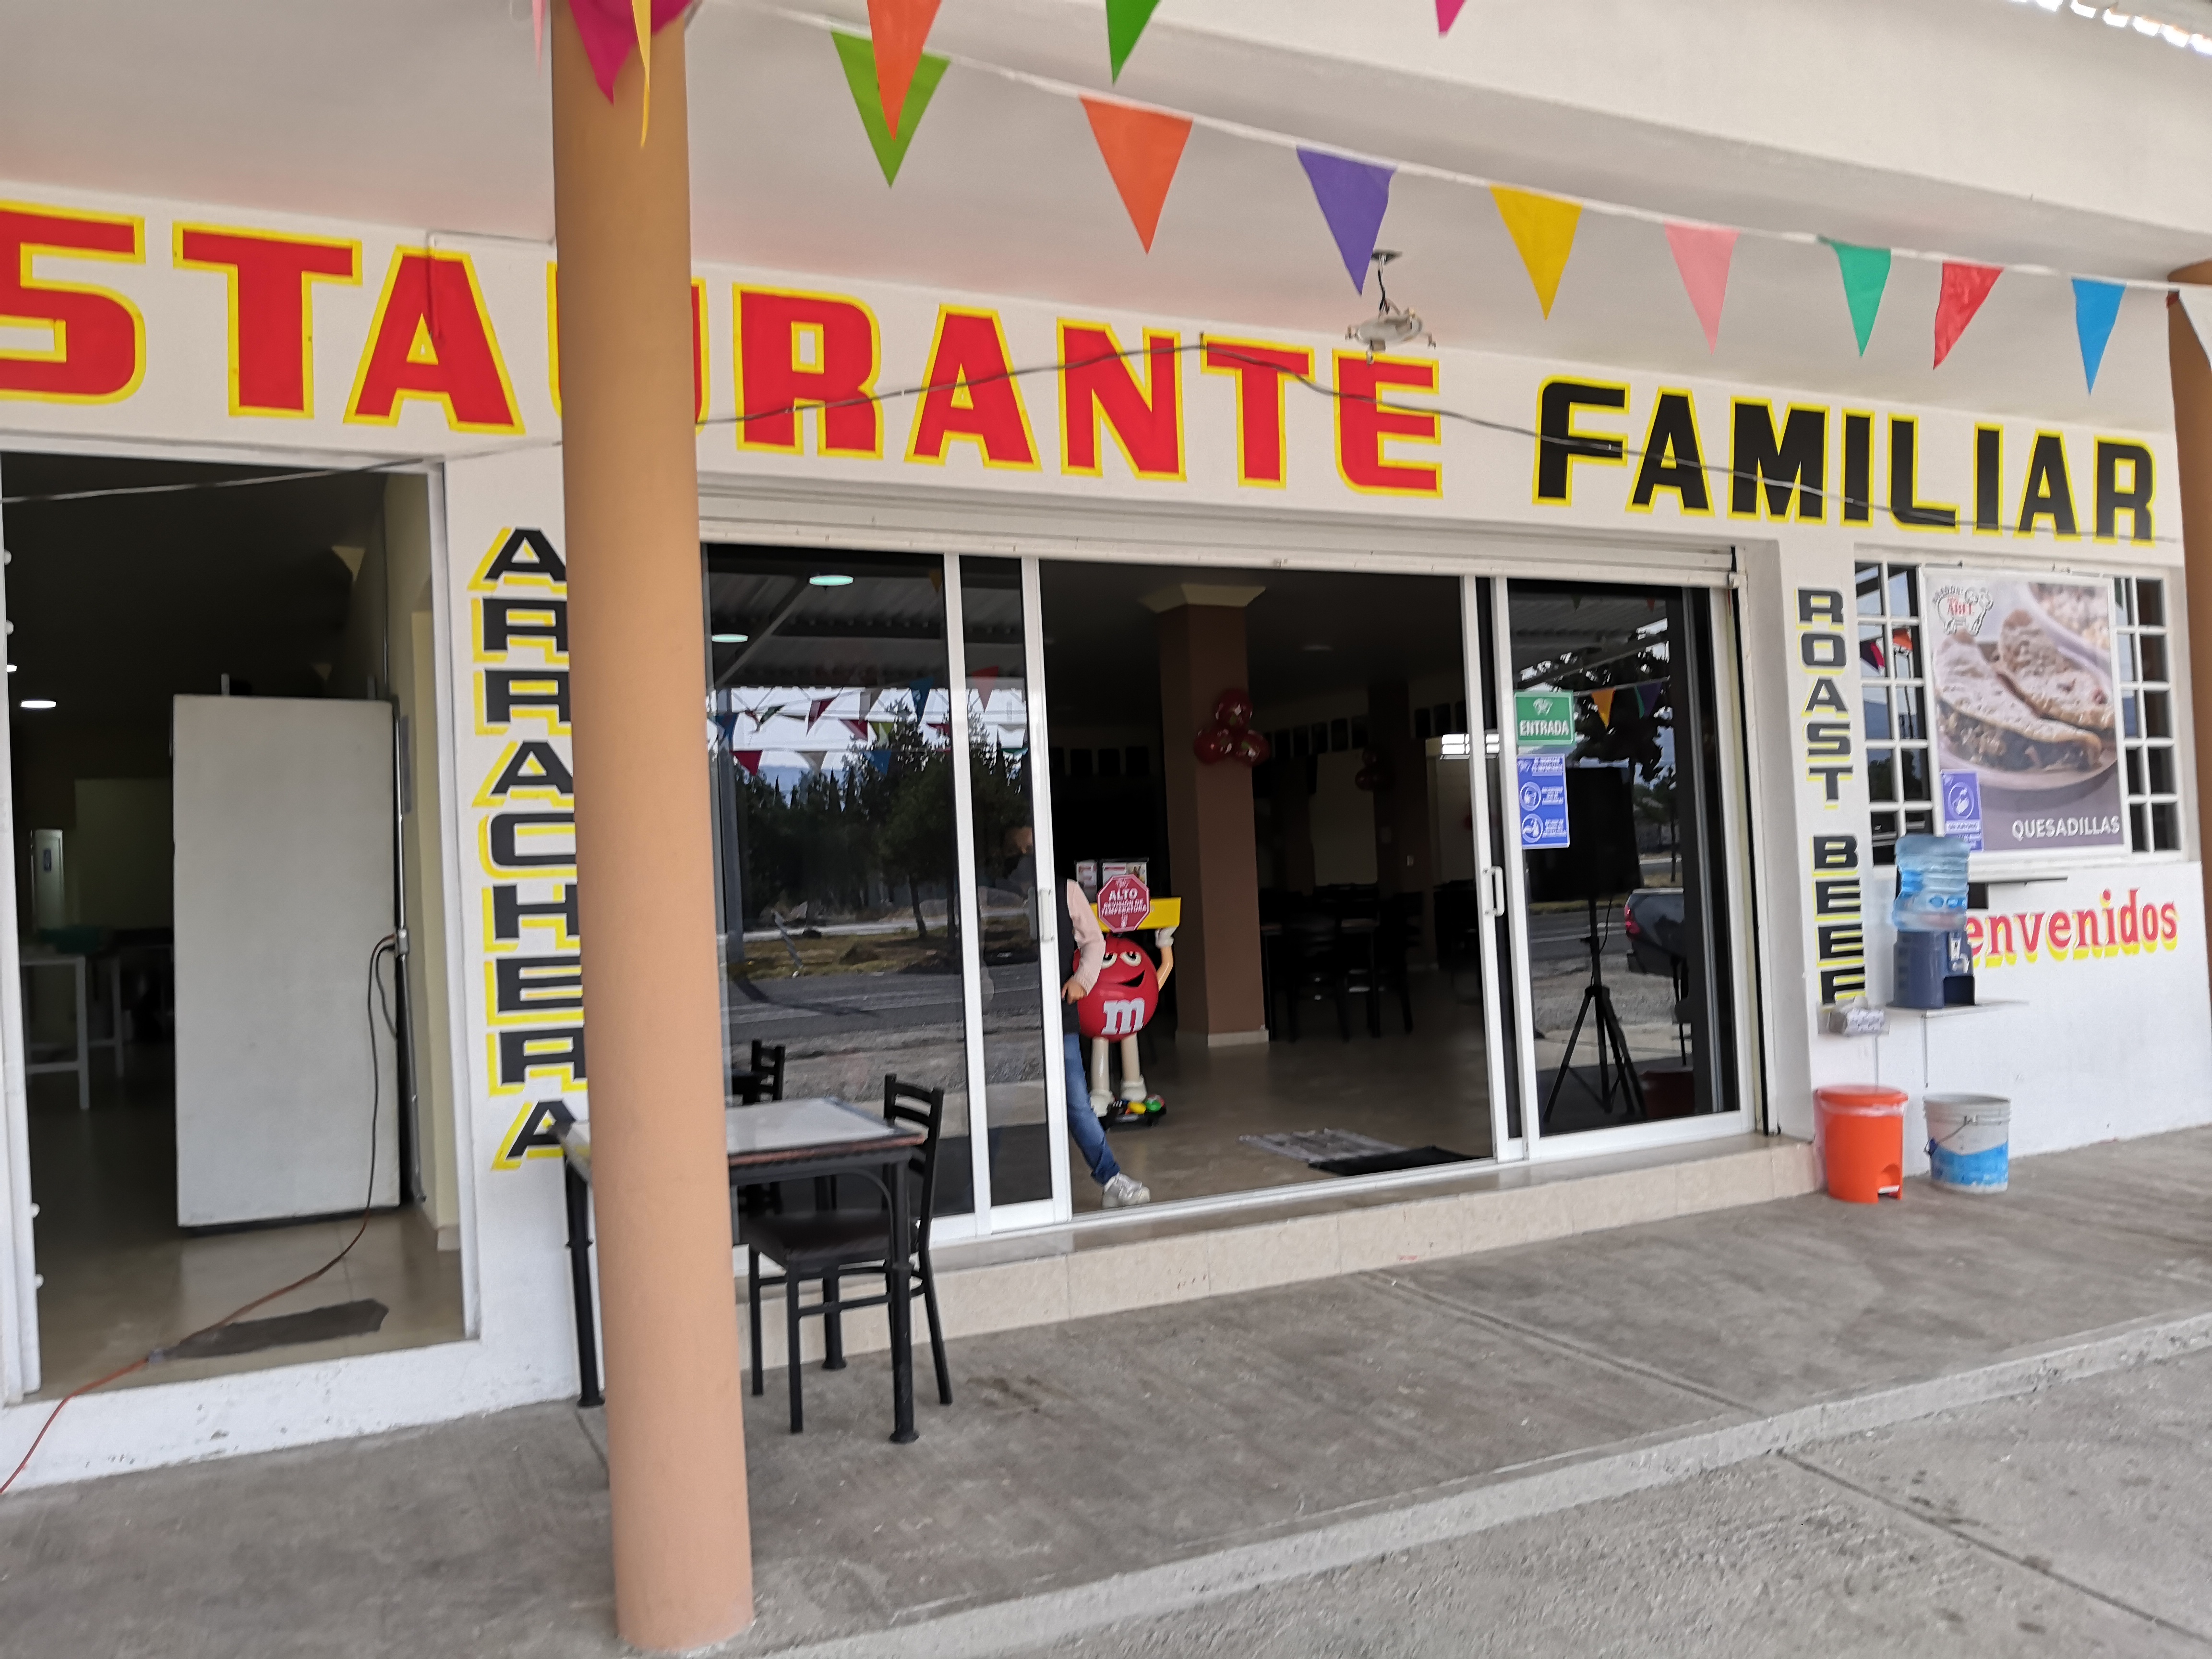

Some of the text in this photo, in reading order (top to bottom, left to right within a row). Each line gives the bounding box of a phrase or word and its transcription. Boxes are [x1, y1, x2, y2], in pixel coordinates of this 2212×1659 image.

[0, 201, 1443, 499] STARANTE
[1532, 374, 2156, 547] FAMILIAR
[1519, 720, 1569, 736] ENTRADA
[1794, 587, 1866, 1006] ROAST BEEF
[468, 527, 589, 1171] ARRACHERA
[1108, 888, 1138, 902] ALTO
[2011, 816, 2120, 841] QUESADILLAS
